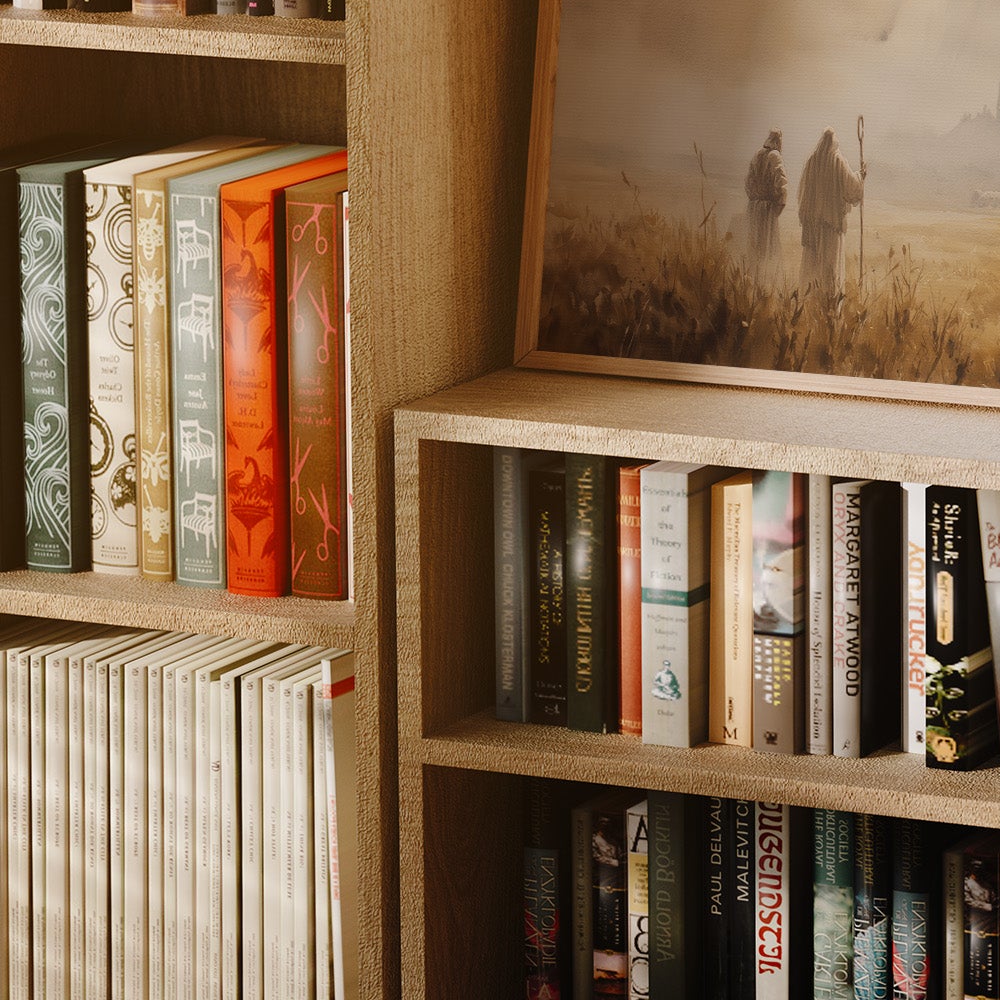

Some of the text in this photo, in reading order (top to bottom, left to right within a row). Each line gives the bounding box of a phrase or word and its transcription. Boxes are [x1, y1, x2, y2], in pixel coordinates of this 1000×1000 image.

[651, 537, 682, 549] Theory
[661, 504, 671, 513] of
[650, 570, 682, 582] Fiction
[833, 492, 846, 668] ORYX AND CRAKE
[846, 493, 860, 697] MARGARET ATWOOD
[501, 609, 514, 691] KLOSTERMAN
[710, 797, 722, 916] PAUL DELVAU
